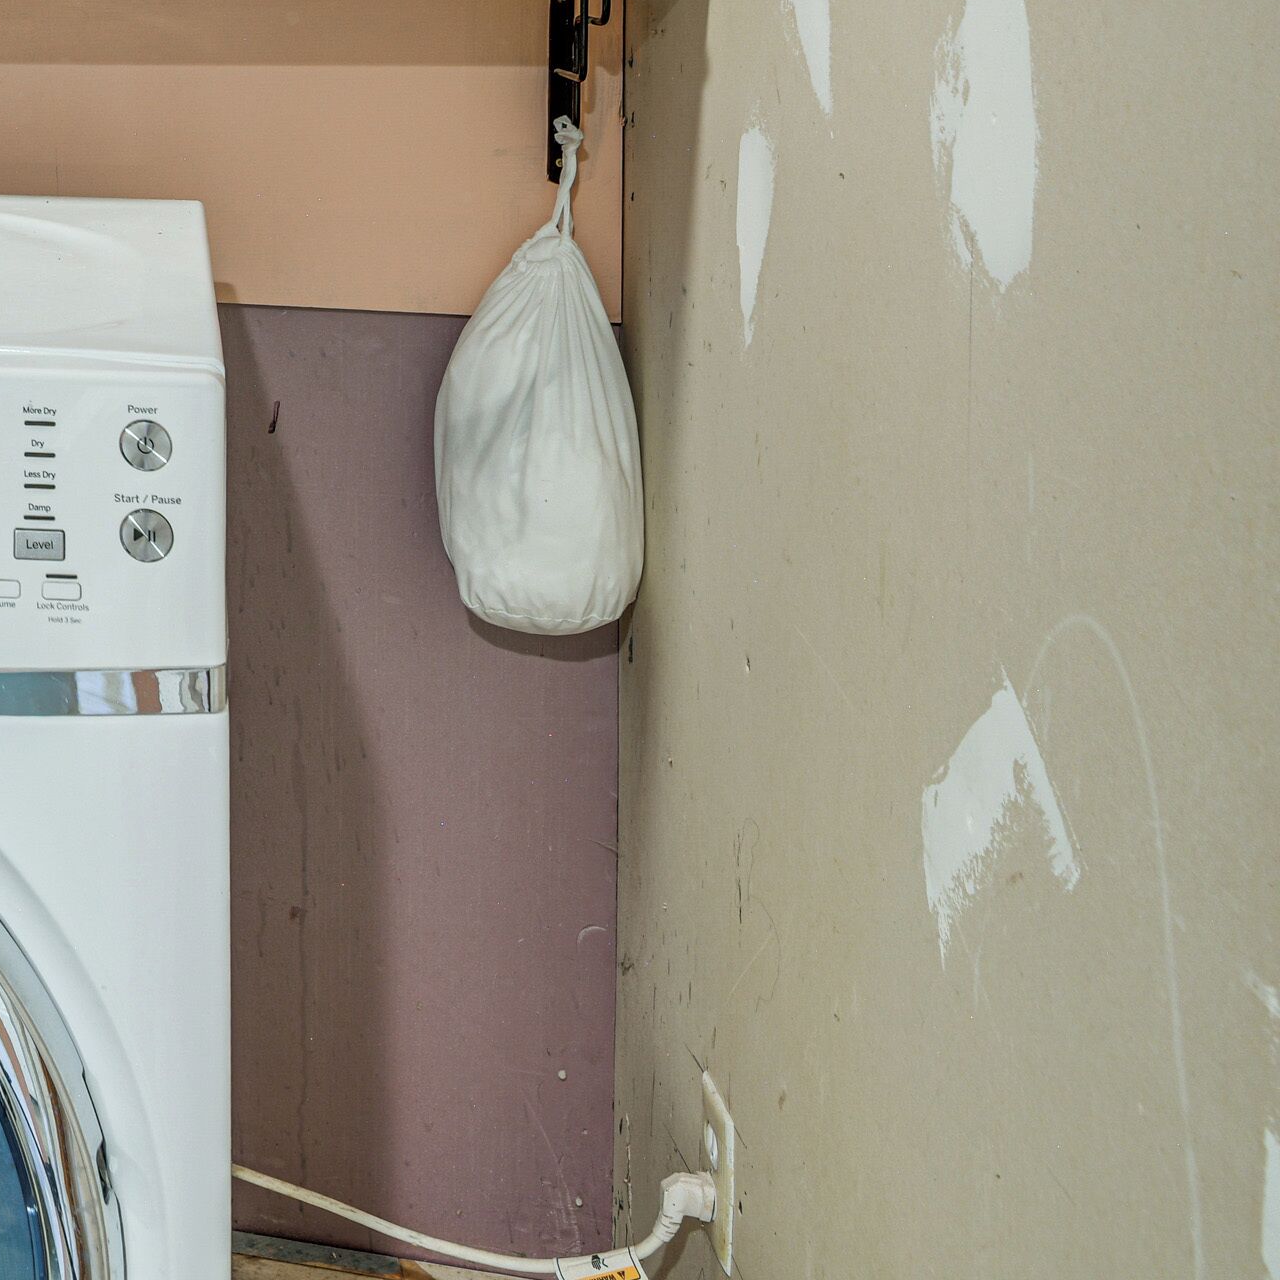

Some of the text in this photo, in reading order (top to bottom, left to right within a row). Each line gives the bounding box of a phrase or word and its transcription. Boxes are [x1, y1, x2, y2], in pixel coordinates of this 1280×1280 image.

[22, 406, 56, 416] More Dry
[128, 404, 158, 415] Power
[31, 439, 44, 448] Dry
[24, 470, 56, 480] Less Dry
[114, 494, 140, 504] Start
[151, 494, 182, 506] Pause
[28, 503, 51, 513] Damp
[26, 539, 54, 550] Level
[36, 601, 90, 612] Lock Controls
